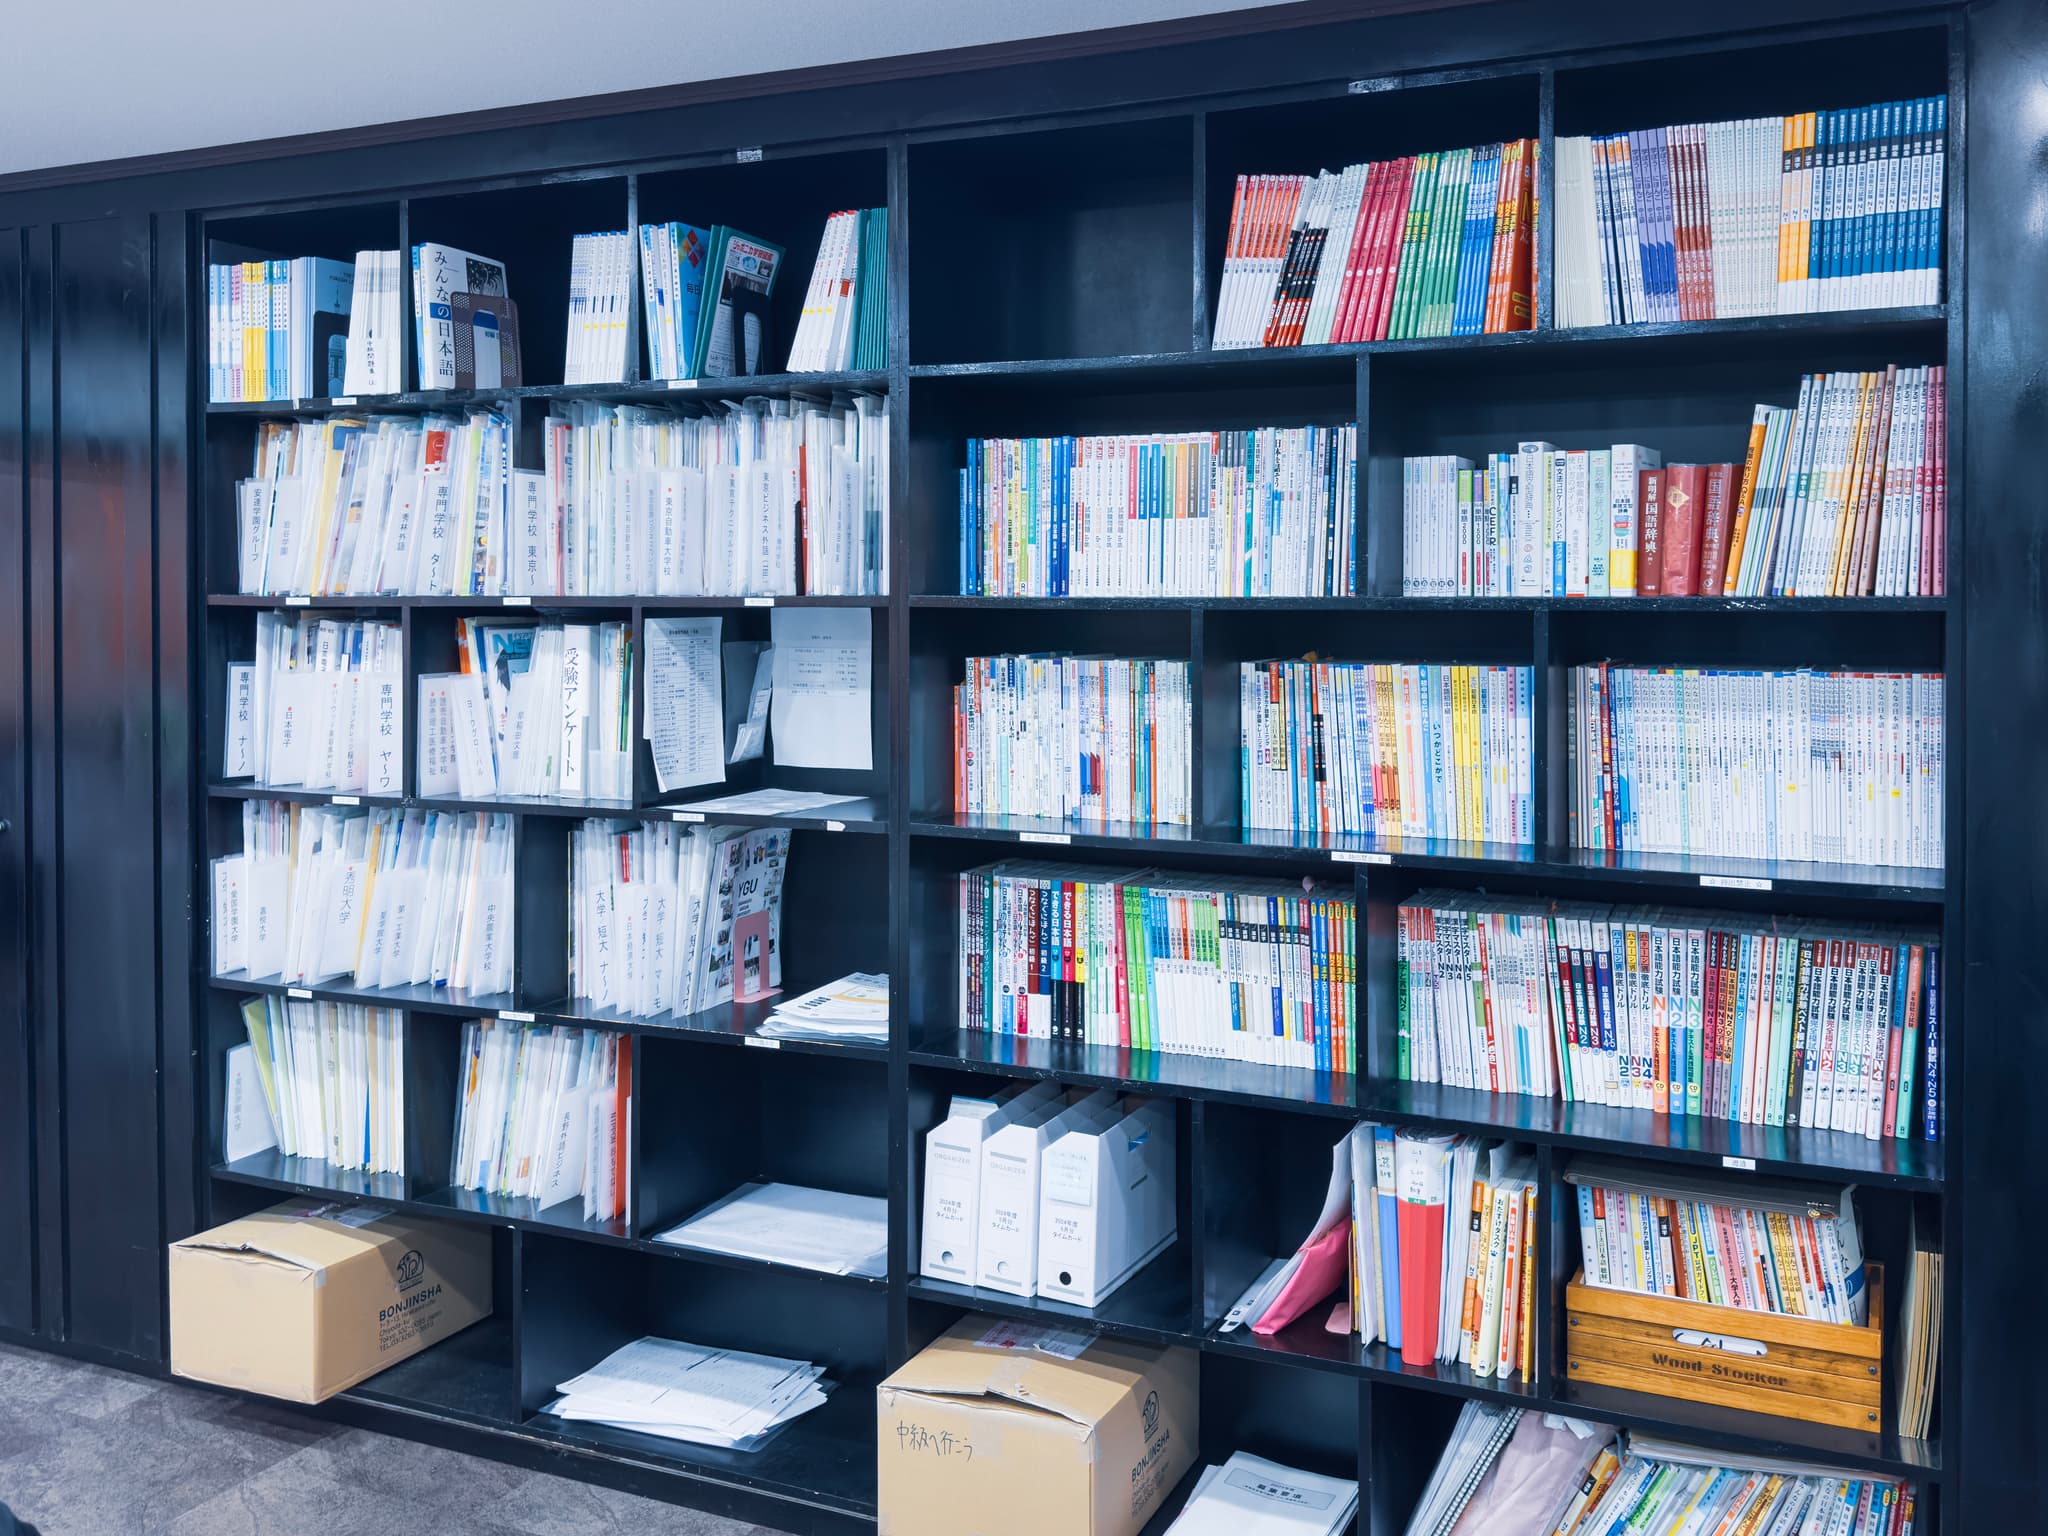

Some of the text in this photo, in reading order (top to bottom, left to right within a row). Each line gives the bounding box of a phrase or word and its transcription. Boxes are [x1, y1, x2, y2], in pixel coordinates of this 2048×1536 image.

[434, 251, 454, 376] みんなの日本語
[433, 487, 448, 538] 専門学校
[527, 481, 537, 537] 専門学校
[1645, 476, 1658, 553] 新明解国語辞典
[239, 672, 249, 721] 専門学校
[380, 684, 392, 736] 専門学校
[564, 648, 580, 777] 受験アンケート
[282, 712, 293, 748] 日本電子
[338, 872, 356, 924] 秀明大学
[737, 878, 758, 898] YGU
[1052, 891, 1060, 945] できる日本語
[1064, 892, 1072, 947] できる日本語
[1654, 937, 1663, 995] 日本語能力試験
[1672, 937, 1680, 995] 日本語能力試験
[1690, 938, 1700, 996] 日本語能力試験
[1856, 961, 1866, 1011] 日本語能力試験
[1867, 960, 1877, 1012] 日本語能力試験
[1613, 931, 1629, 1077] パターン別 徹底ドリル N2
[1627, 932, 1641, 1077] パターン別 徹底ドリル N3
[1640, 932, 1653, 1078] パターン別 徹底ドリル N4
[1654, 995, 1666, 1025] N1
[1670, 997, 1683, 1027] N2
[1688, 997, 1700, 1028] N3
[1811, 968, 1822, 1020] 日本語能力試験
[1842, 969, 1853, 1021] 日本語能力試験
[1567, 1024, 1575, 1041] N1
[1579, 1027, 1587, 1044] N2
[1591, 1028, 1599, 1045] N3
[1822, 968, 1838, 1071] 日本語能力試験 完全模試 N2
[1873, 976, 1889, 1081] 日本語能力試験 完全模試 N4
[1805, 1051, 1817, 1070] N1
[1837, 1052, 1847, 1072] N3
[1849, 1053, 1860, 1074] N3
[1861, 1055, 1870, 1076] N4
[935, 1153, 970, 1164] ORGANIZER
[991, 1162, 1026, 1174] ORGANIZER
[936, 1212, 963, 1221] タイムカード
[992, 1222, 1019, 1232] タイムカード
[1052, 1232, 1082, 1241] タイムカード
[1494, 1198, 1504, 1248] おたすけタスク
[379, 1284, 442, 1321] BONJINSHA
[1652, 1353, 1788, 1386] Wood Stocker
[896, 1420, 974, 1463] 中級へ行こう
[1132, 1428, 1170, 1482] BONJINSHA
